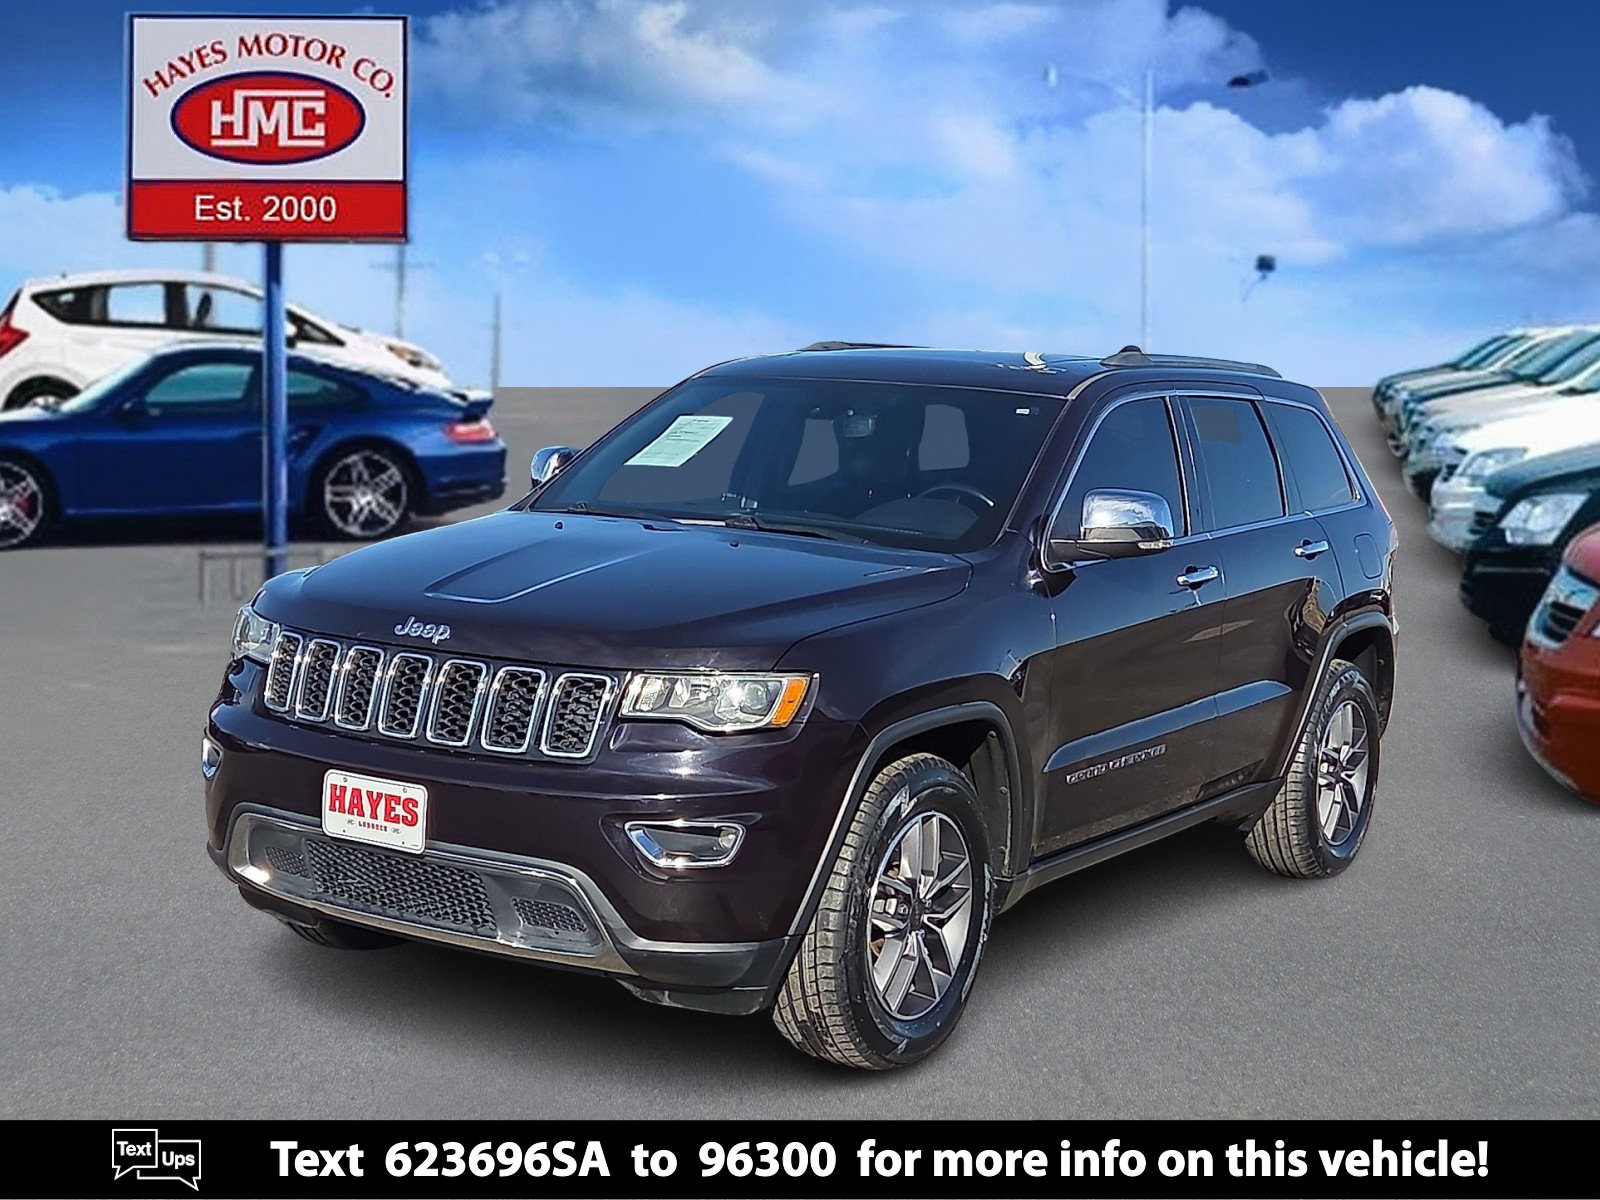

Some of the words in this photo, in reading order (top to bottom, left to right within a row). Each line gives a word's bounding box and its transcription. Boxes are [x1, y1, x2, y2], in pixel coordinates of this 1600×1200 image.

[143, 41, 228, 97] HAYES
[238, 33, 347, 69] MOTOR
[352, 57, 395, 98] CO.
[210, 88, 326, 147] HMC
[195, 194, 250, 222] Est.
[262, 195, 337, 222] 2000
[394, 616, 451, 645] Jeep
[328, 783, 419, 827] HAYES
